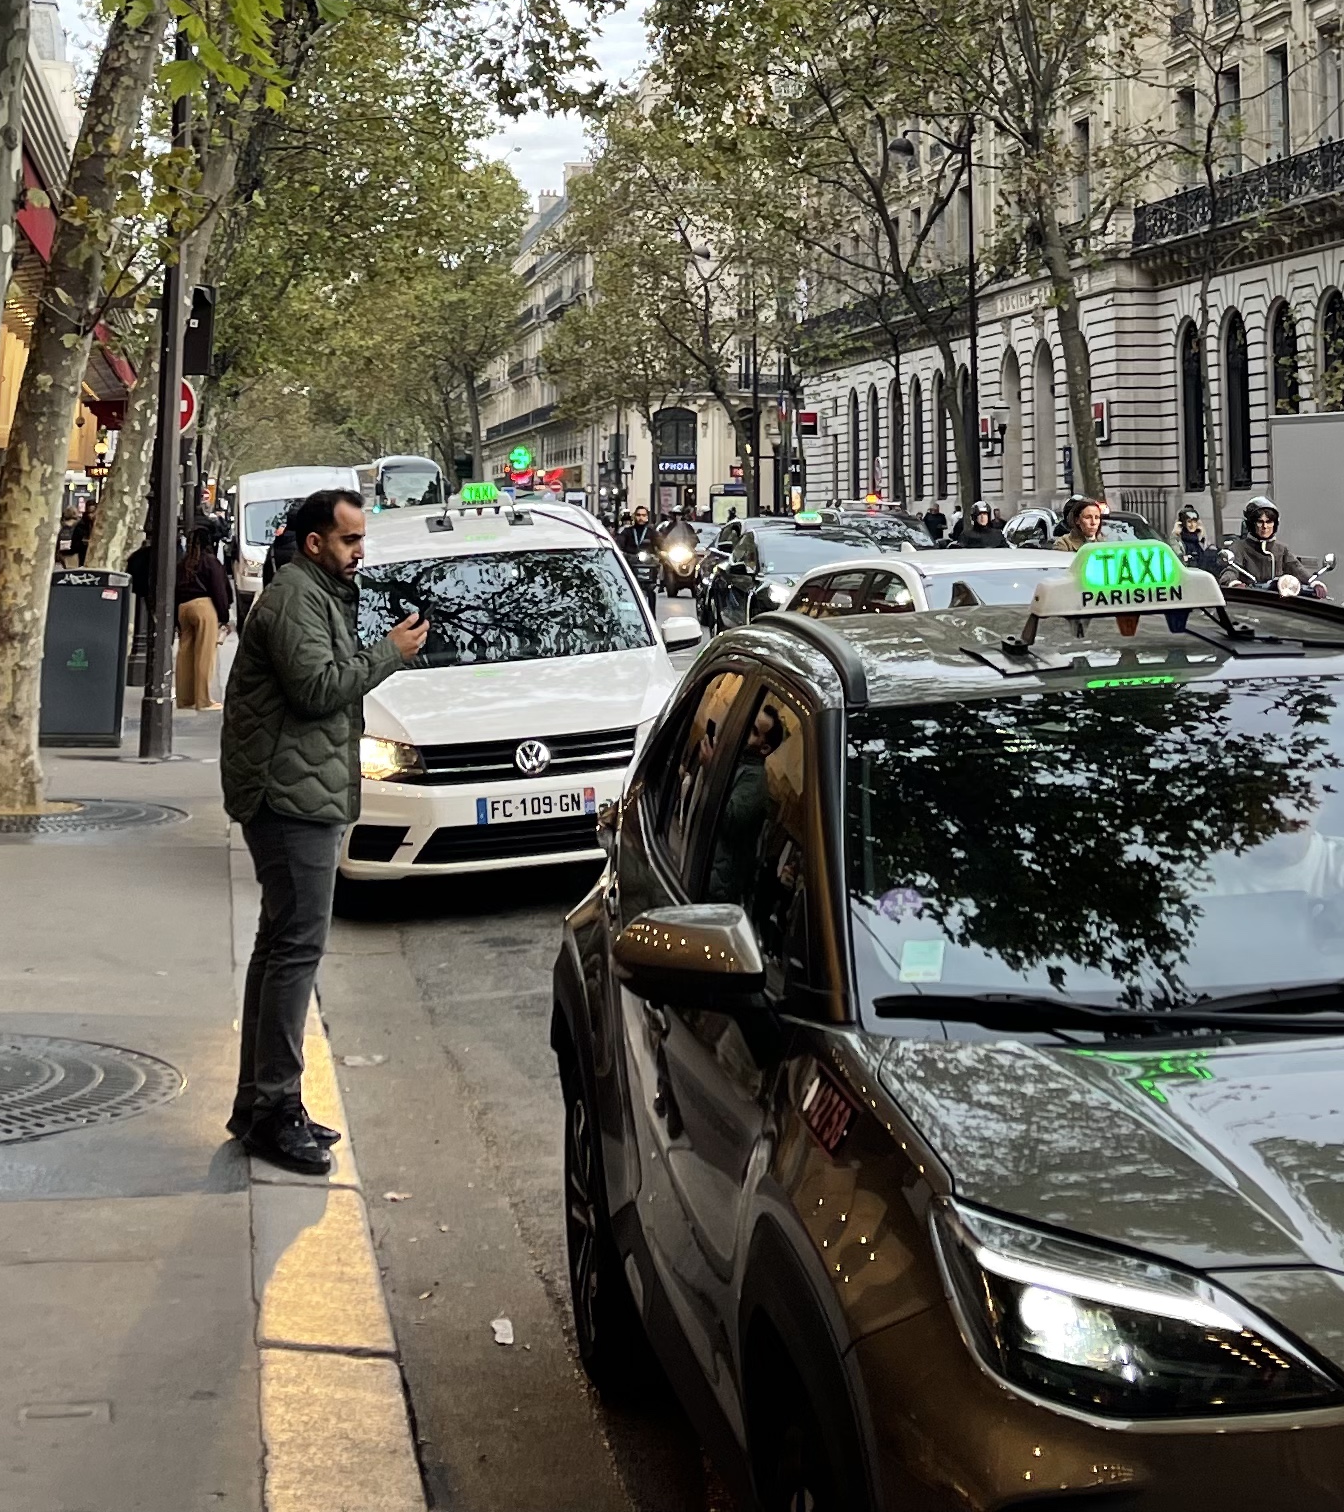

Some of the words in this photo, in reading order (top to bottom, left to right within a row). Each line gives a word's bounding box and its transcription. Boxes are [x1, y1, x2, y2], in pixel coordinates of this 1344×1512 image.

[468, 485, 494, 500] TAXI
[1096, 549, 1168, 586] TAXI
[1082, 585, 1183, 607] PARISIEN
[490, 792, 581, 820] FC-109-GN
